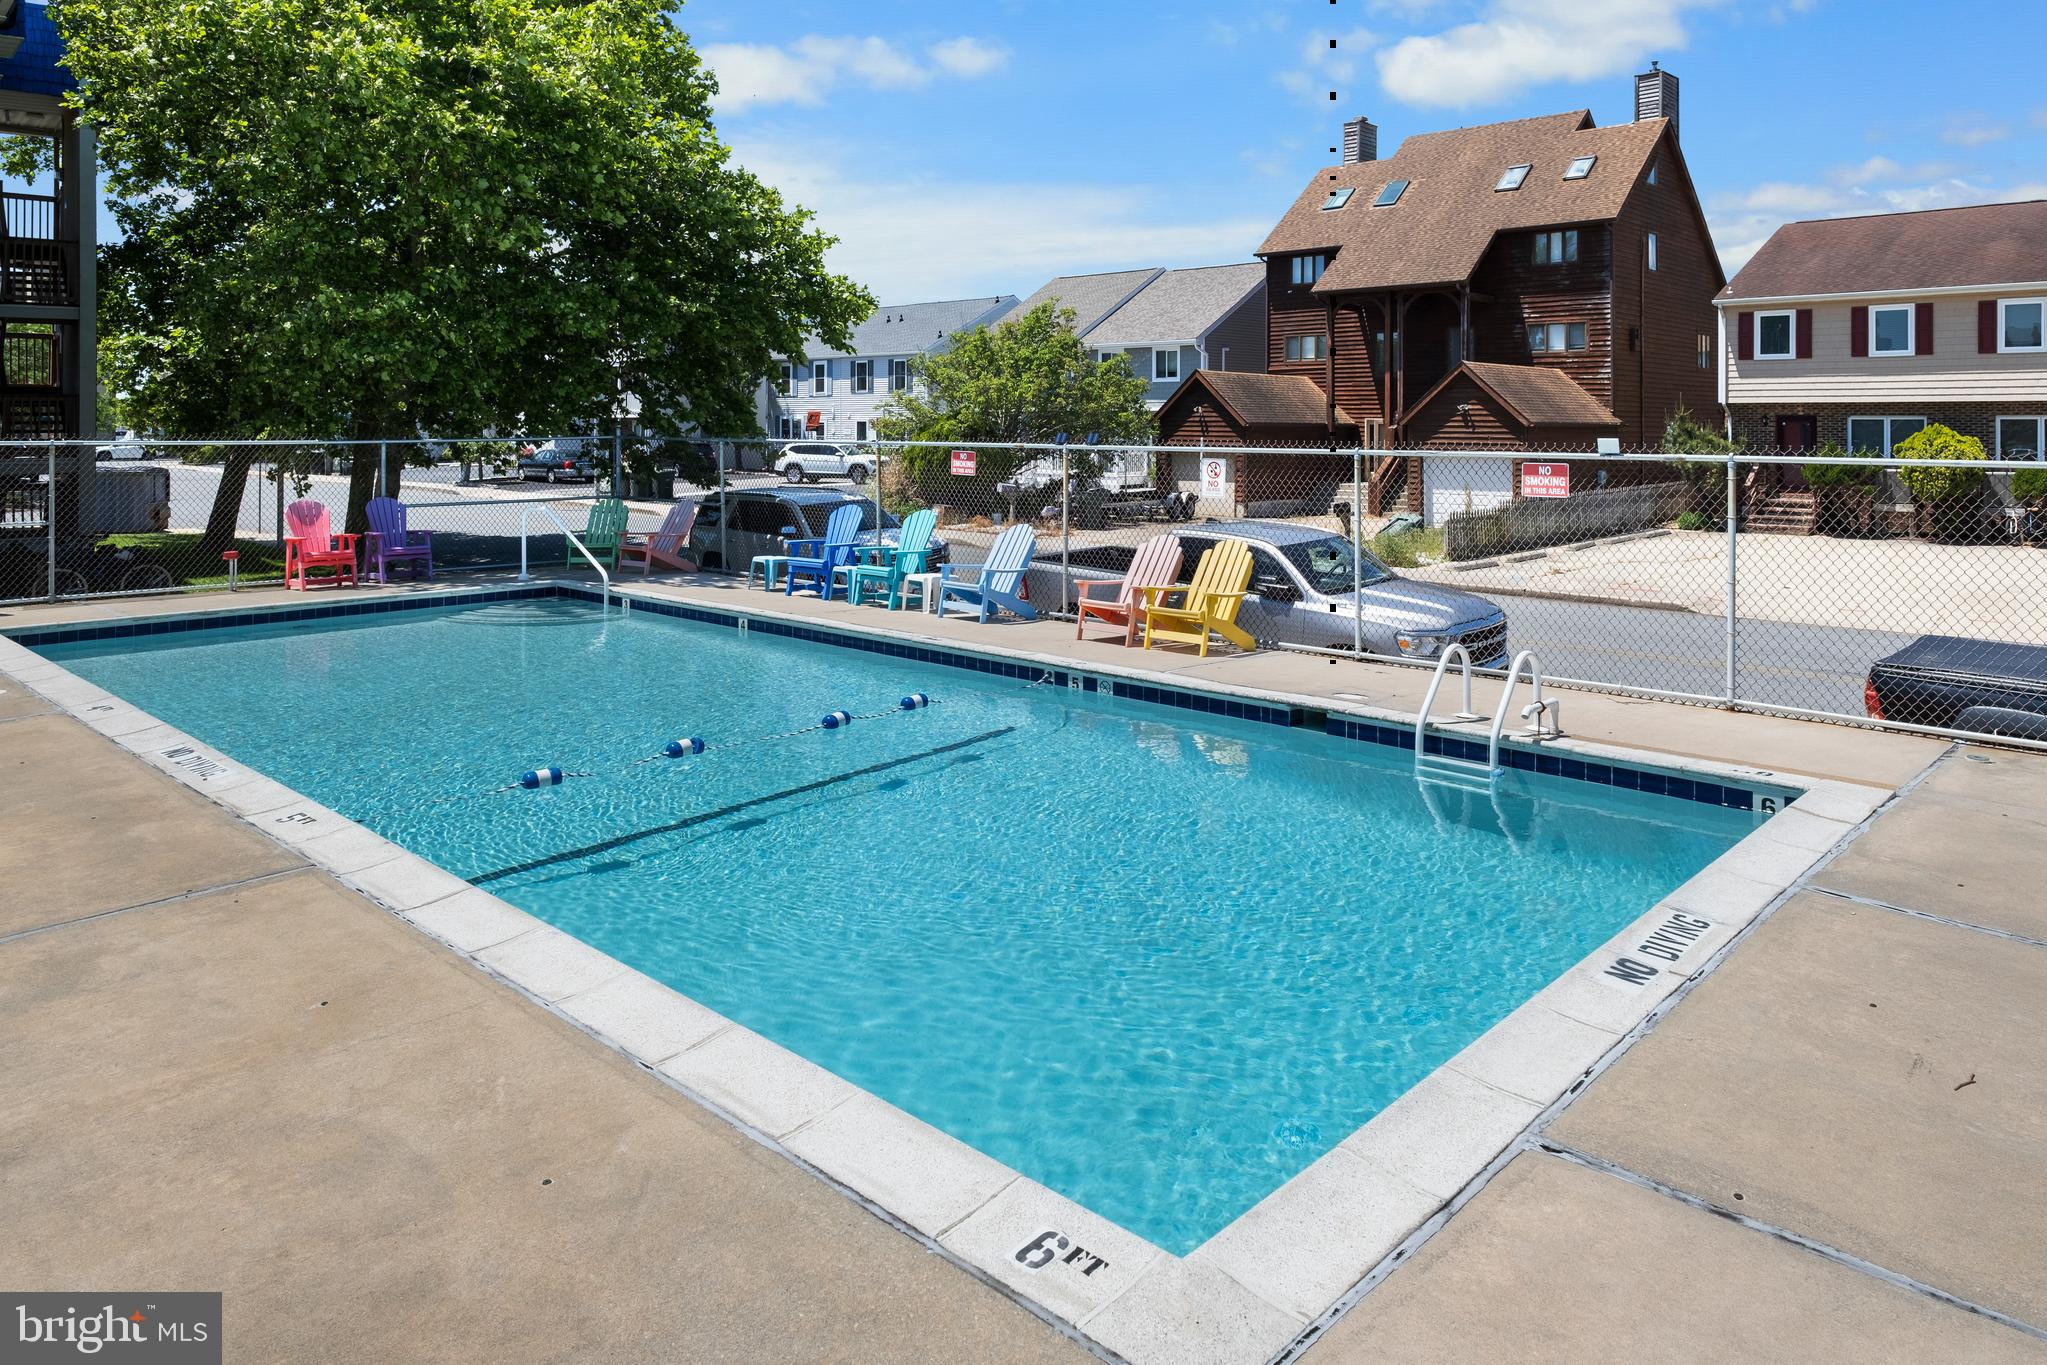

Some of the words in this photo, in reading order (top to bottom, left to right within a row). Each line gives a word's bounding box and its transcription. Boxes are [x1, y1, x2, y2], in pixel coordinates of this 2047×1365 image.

[1538, 465, 1552, 476] NO
[1207, 480, 1219, 488] NO
[1525, 476, 1566, 487] SMOKING
[1532, 487, 1547, 495] THIS
[740, 619, 746, 629] 4
[1071, 676, 1080, 689] 5
[160, 746, 195, 758] NO
[1761, 797, 1776, 815] 6
[1603, 957, 1659, 986] NO
[1637, 914, 1711, 962] DIVING
[1015, 1230, 1070, 1269] 6
[1061, 1245, 1110, 1277] FT
